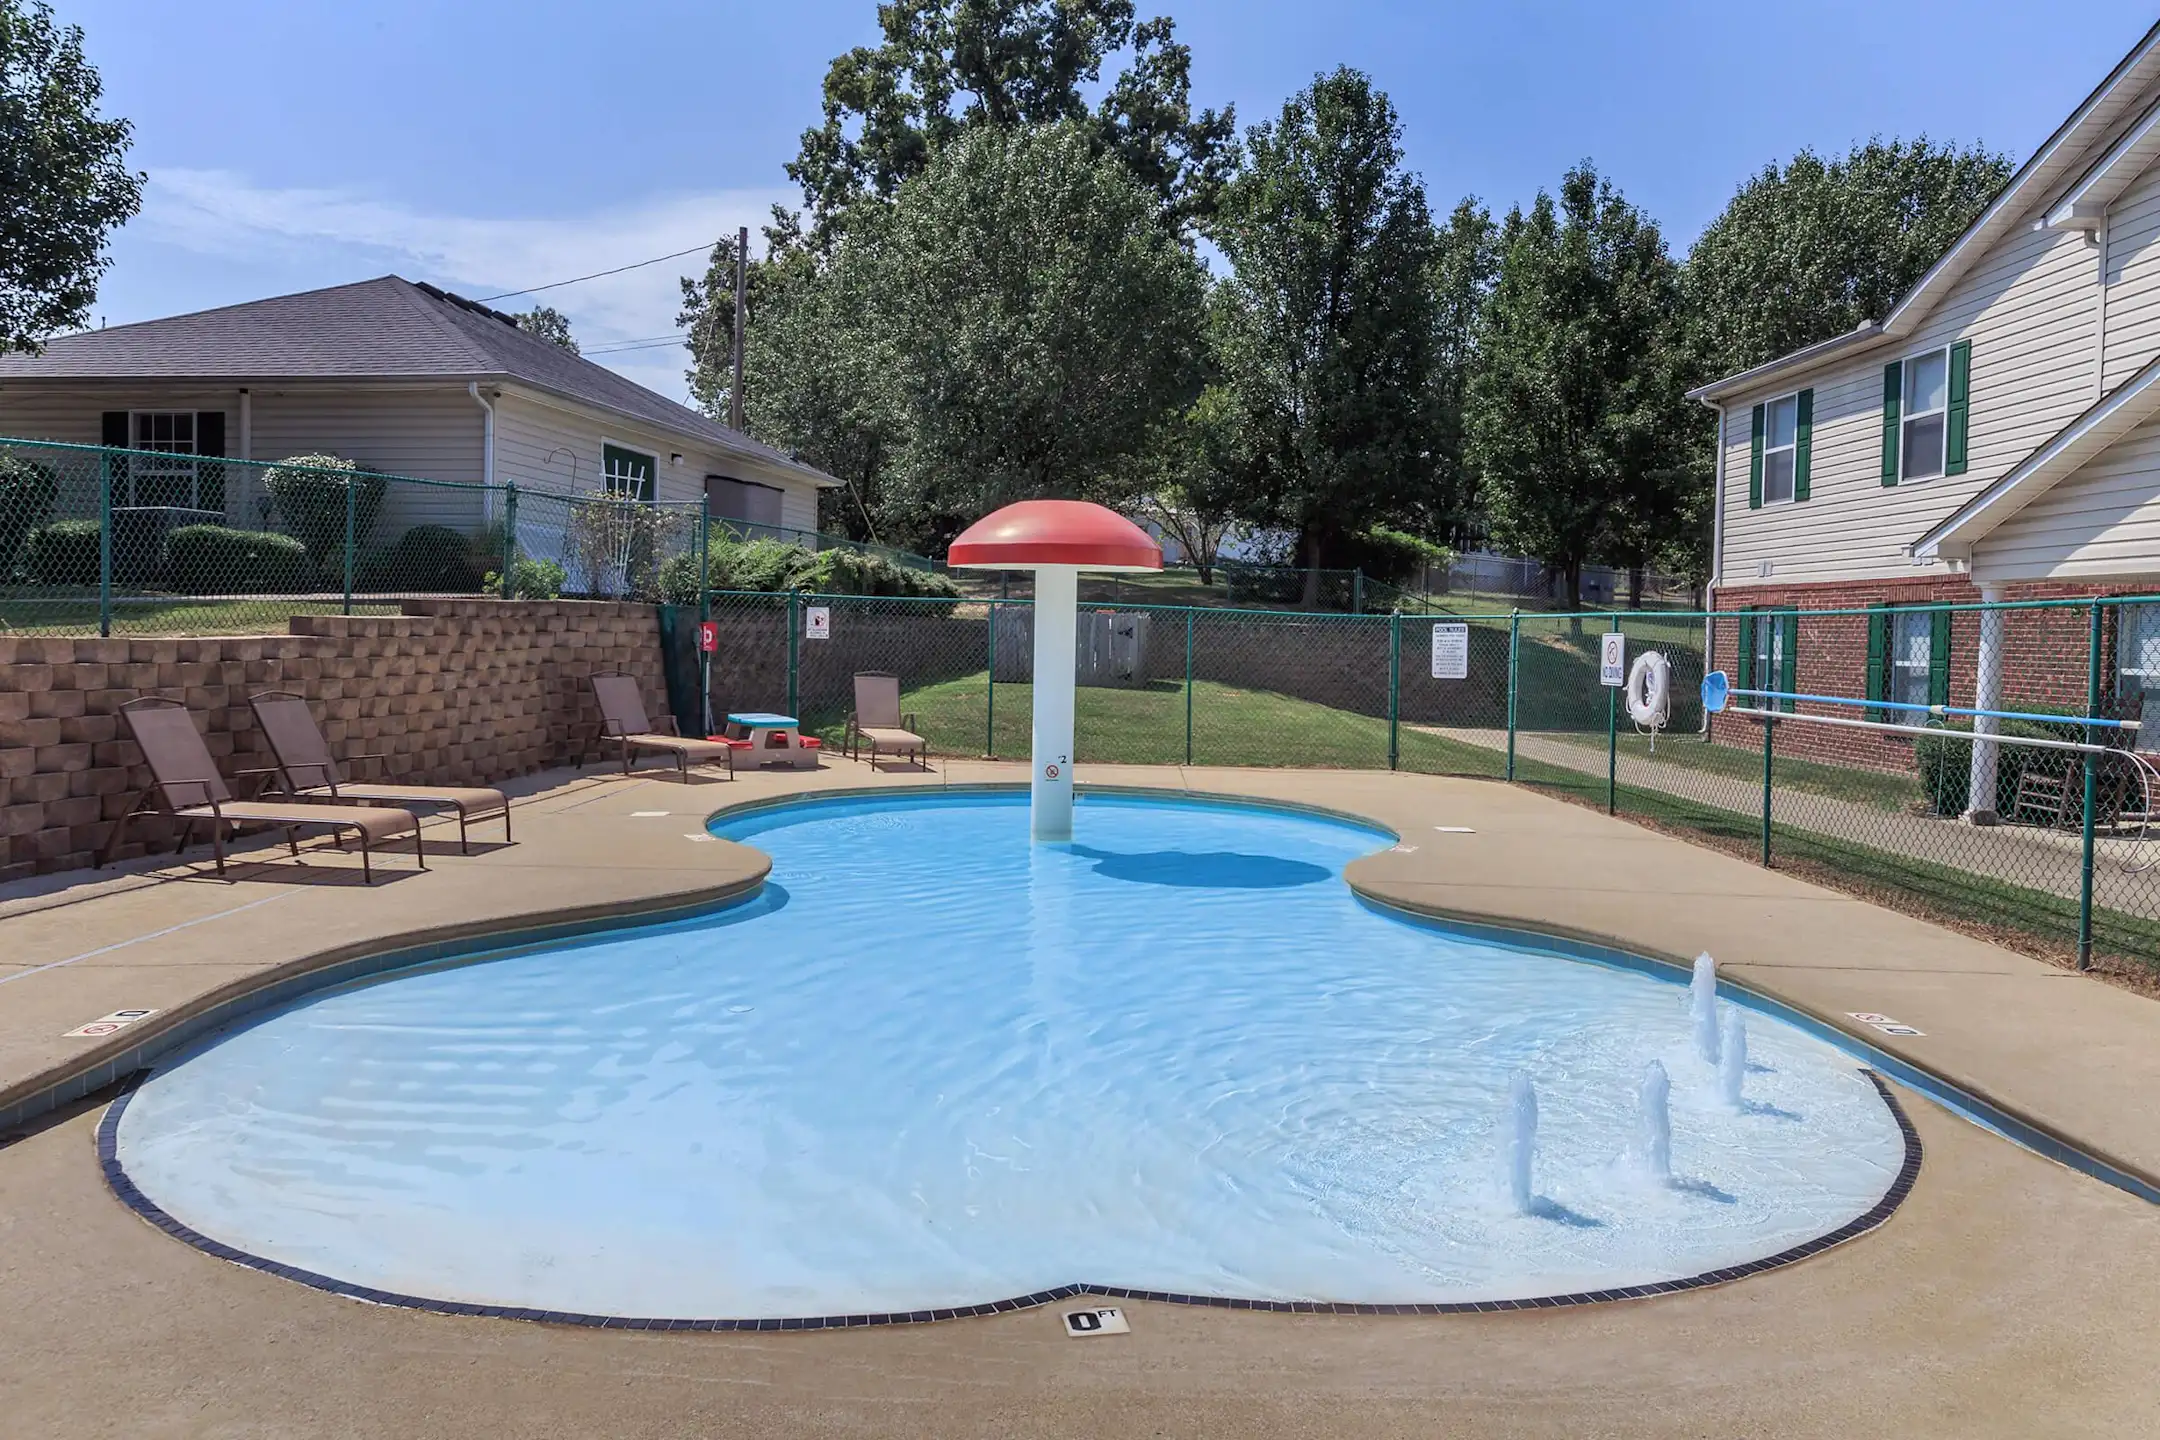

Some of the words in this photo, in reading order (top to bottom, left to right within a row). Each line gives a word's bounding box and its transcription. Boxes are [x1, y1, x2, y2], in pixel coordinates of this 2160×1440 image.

[1602, 666, 1609, 678] NO
[1068, 1312, 1102, 1331] 0
[1097, 1310, 1116, 1318] FT
